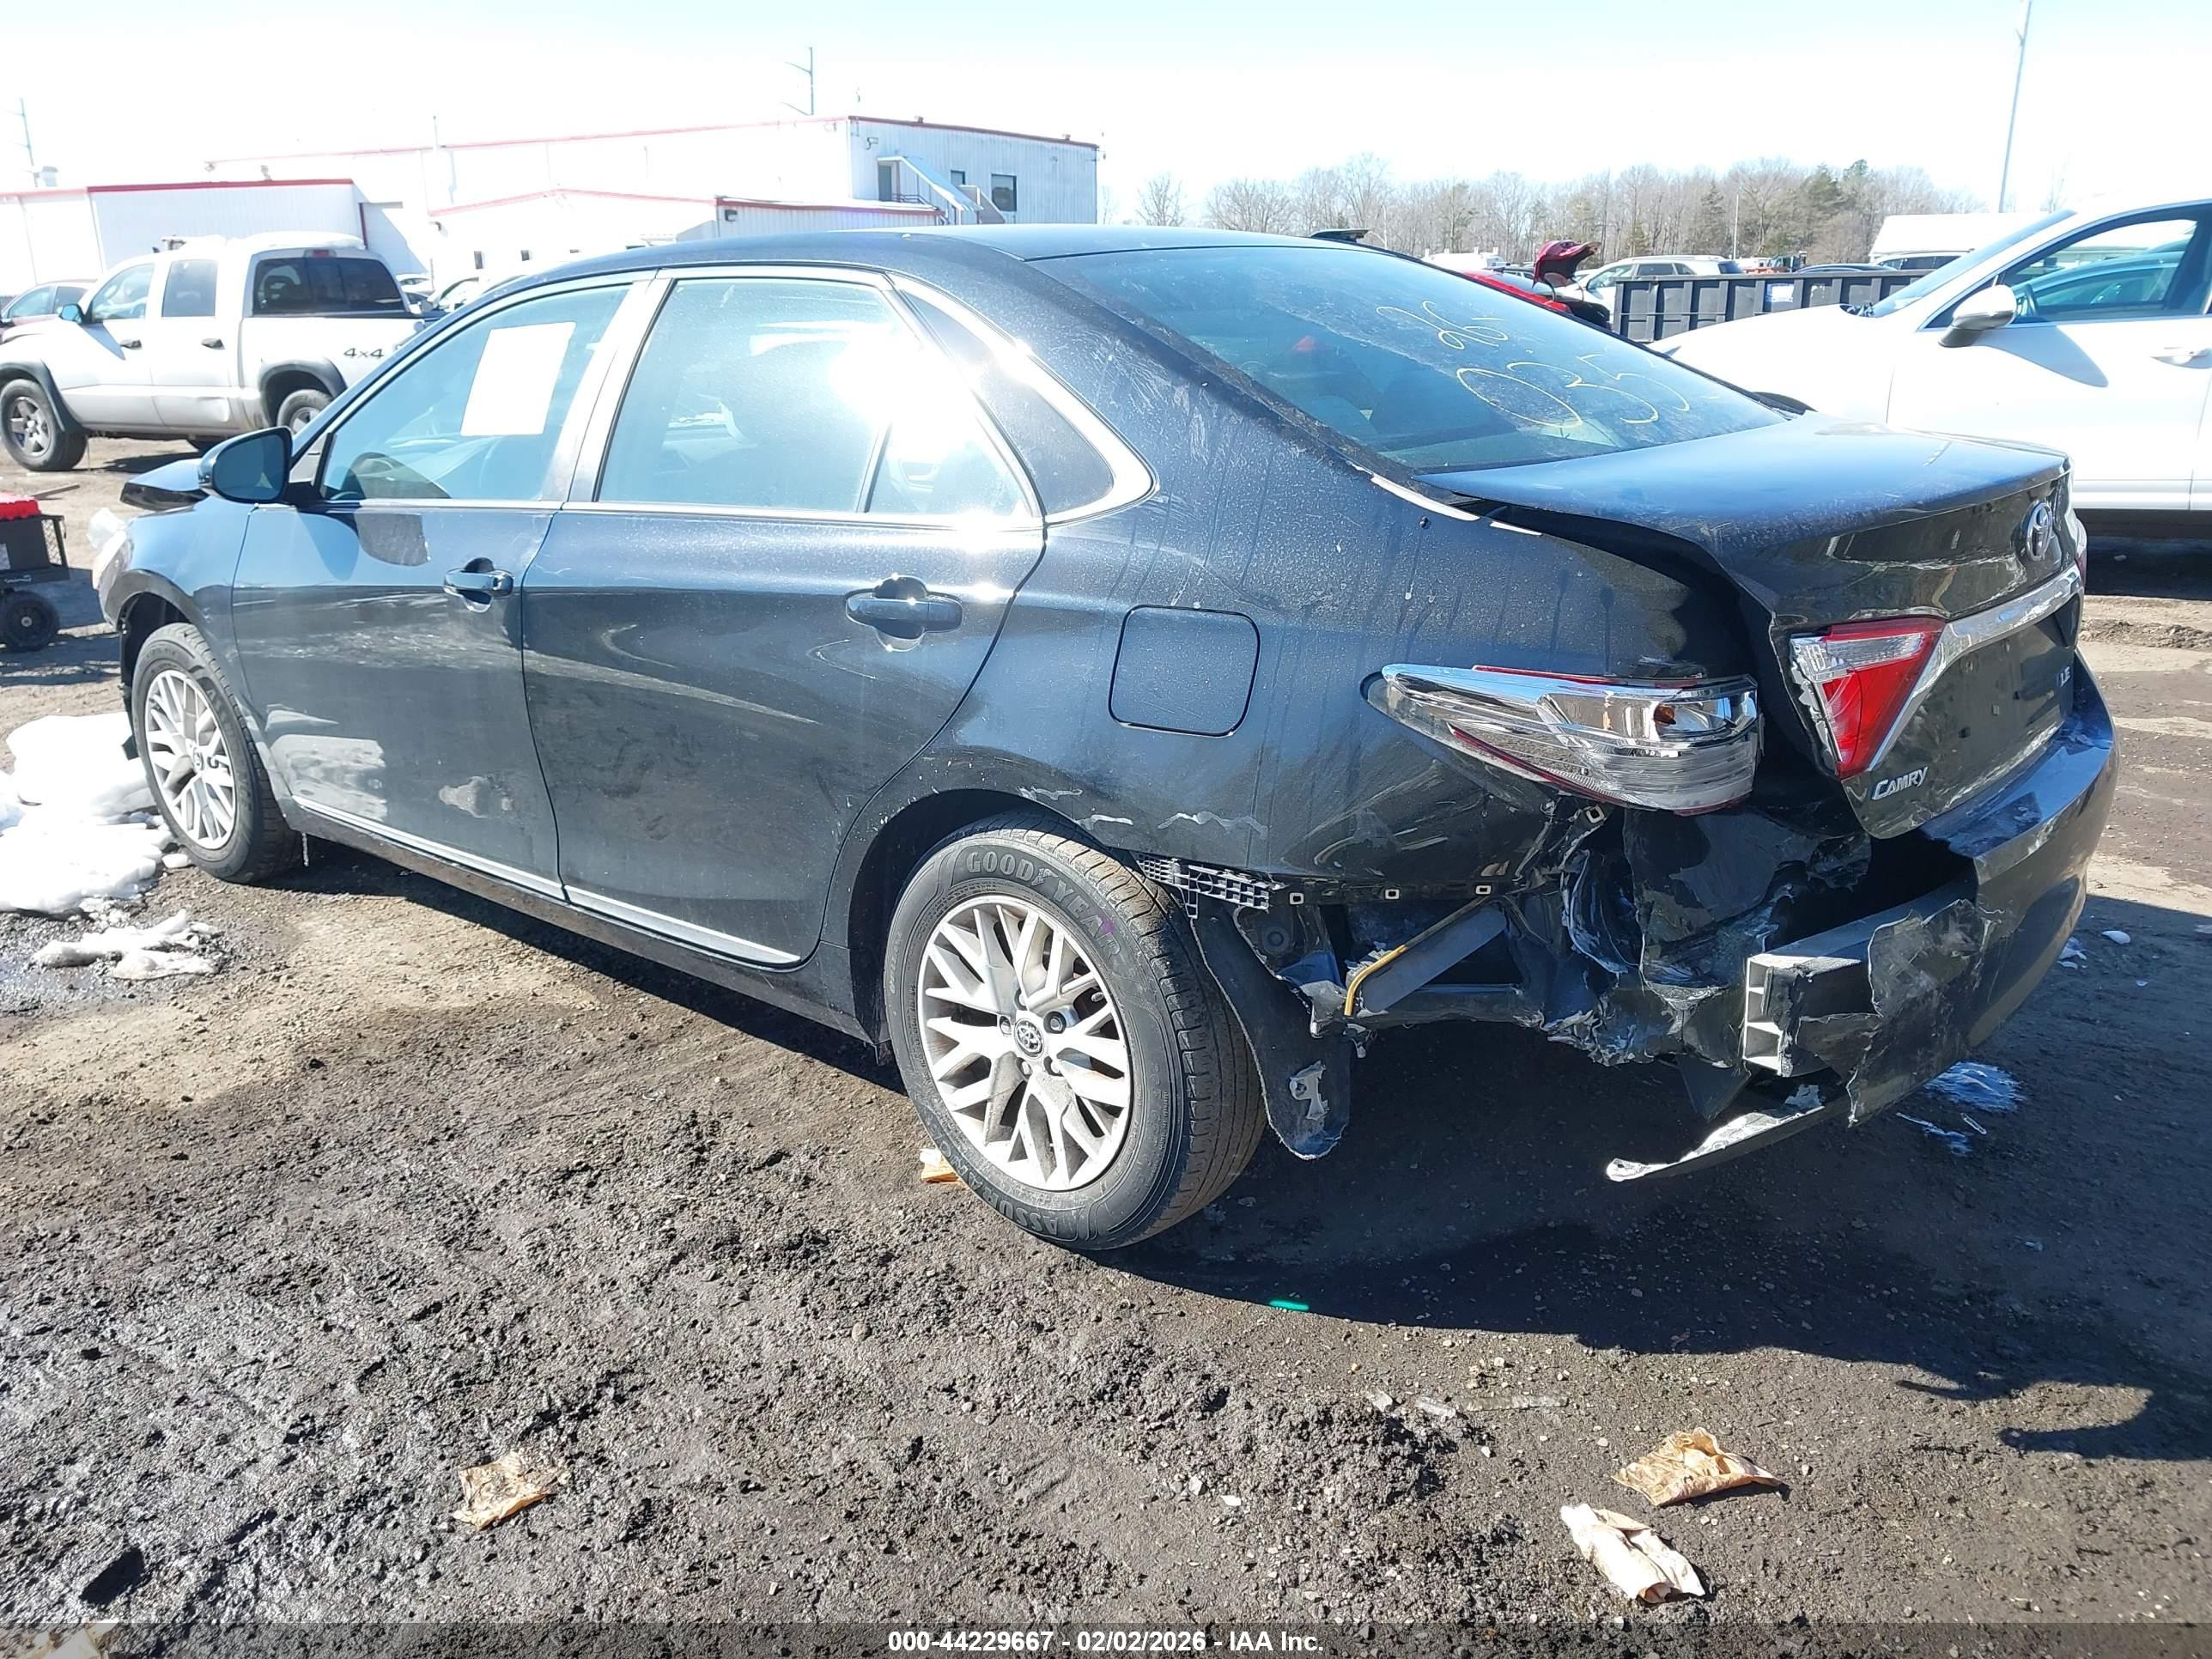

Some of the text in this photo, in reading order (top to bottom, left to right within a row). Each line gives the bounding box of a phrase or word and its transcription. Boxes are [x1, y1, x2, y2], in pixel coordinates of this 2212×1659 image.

[343, 347, 385, 359] 4x4
[1456, 354, 1690, 428] 035
[1871, 766, 1929, 801] CAMRY
